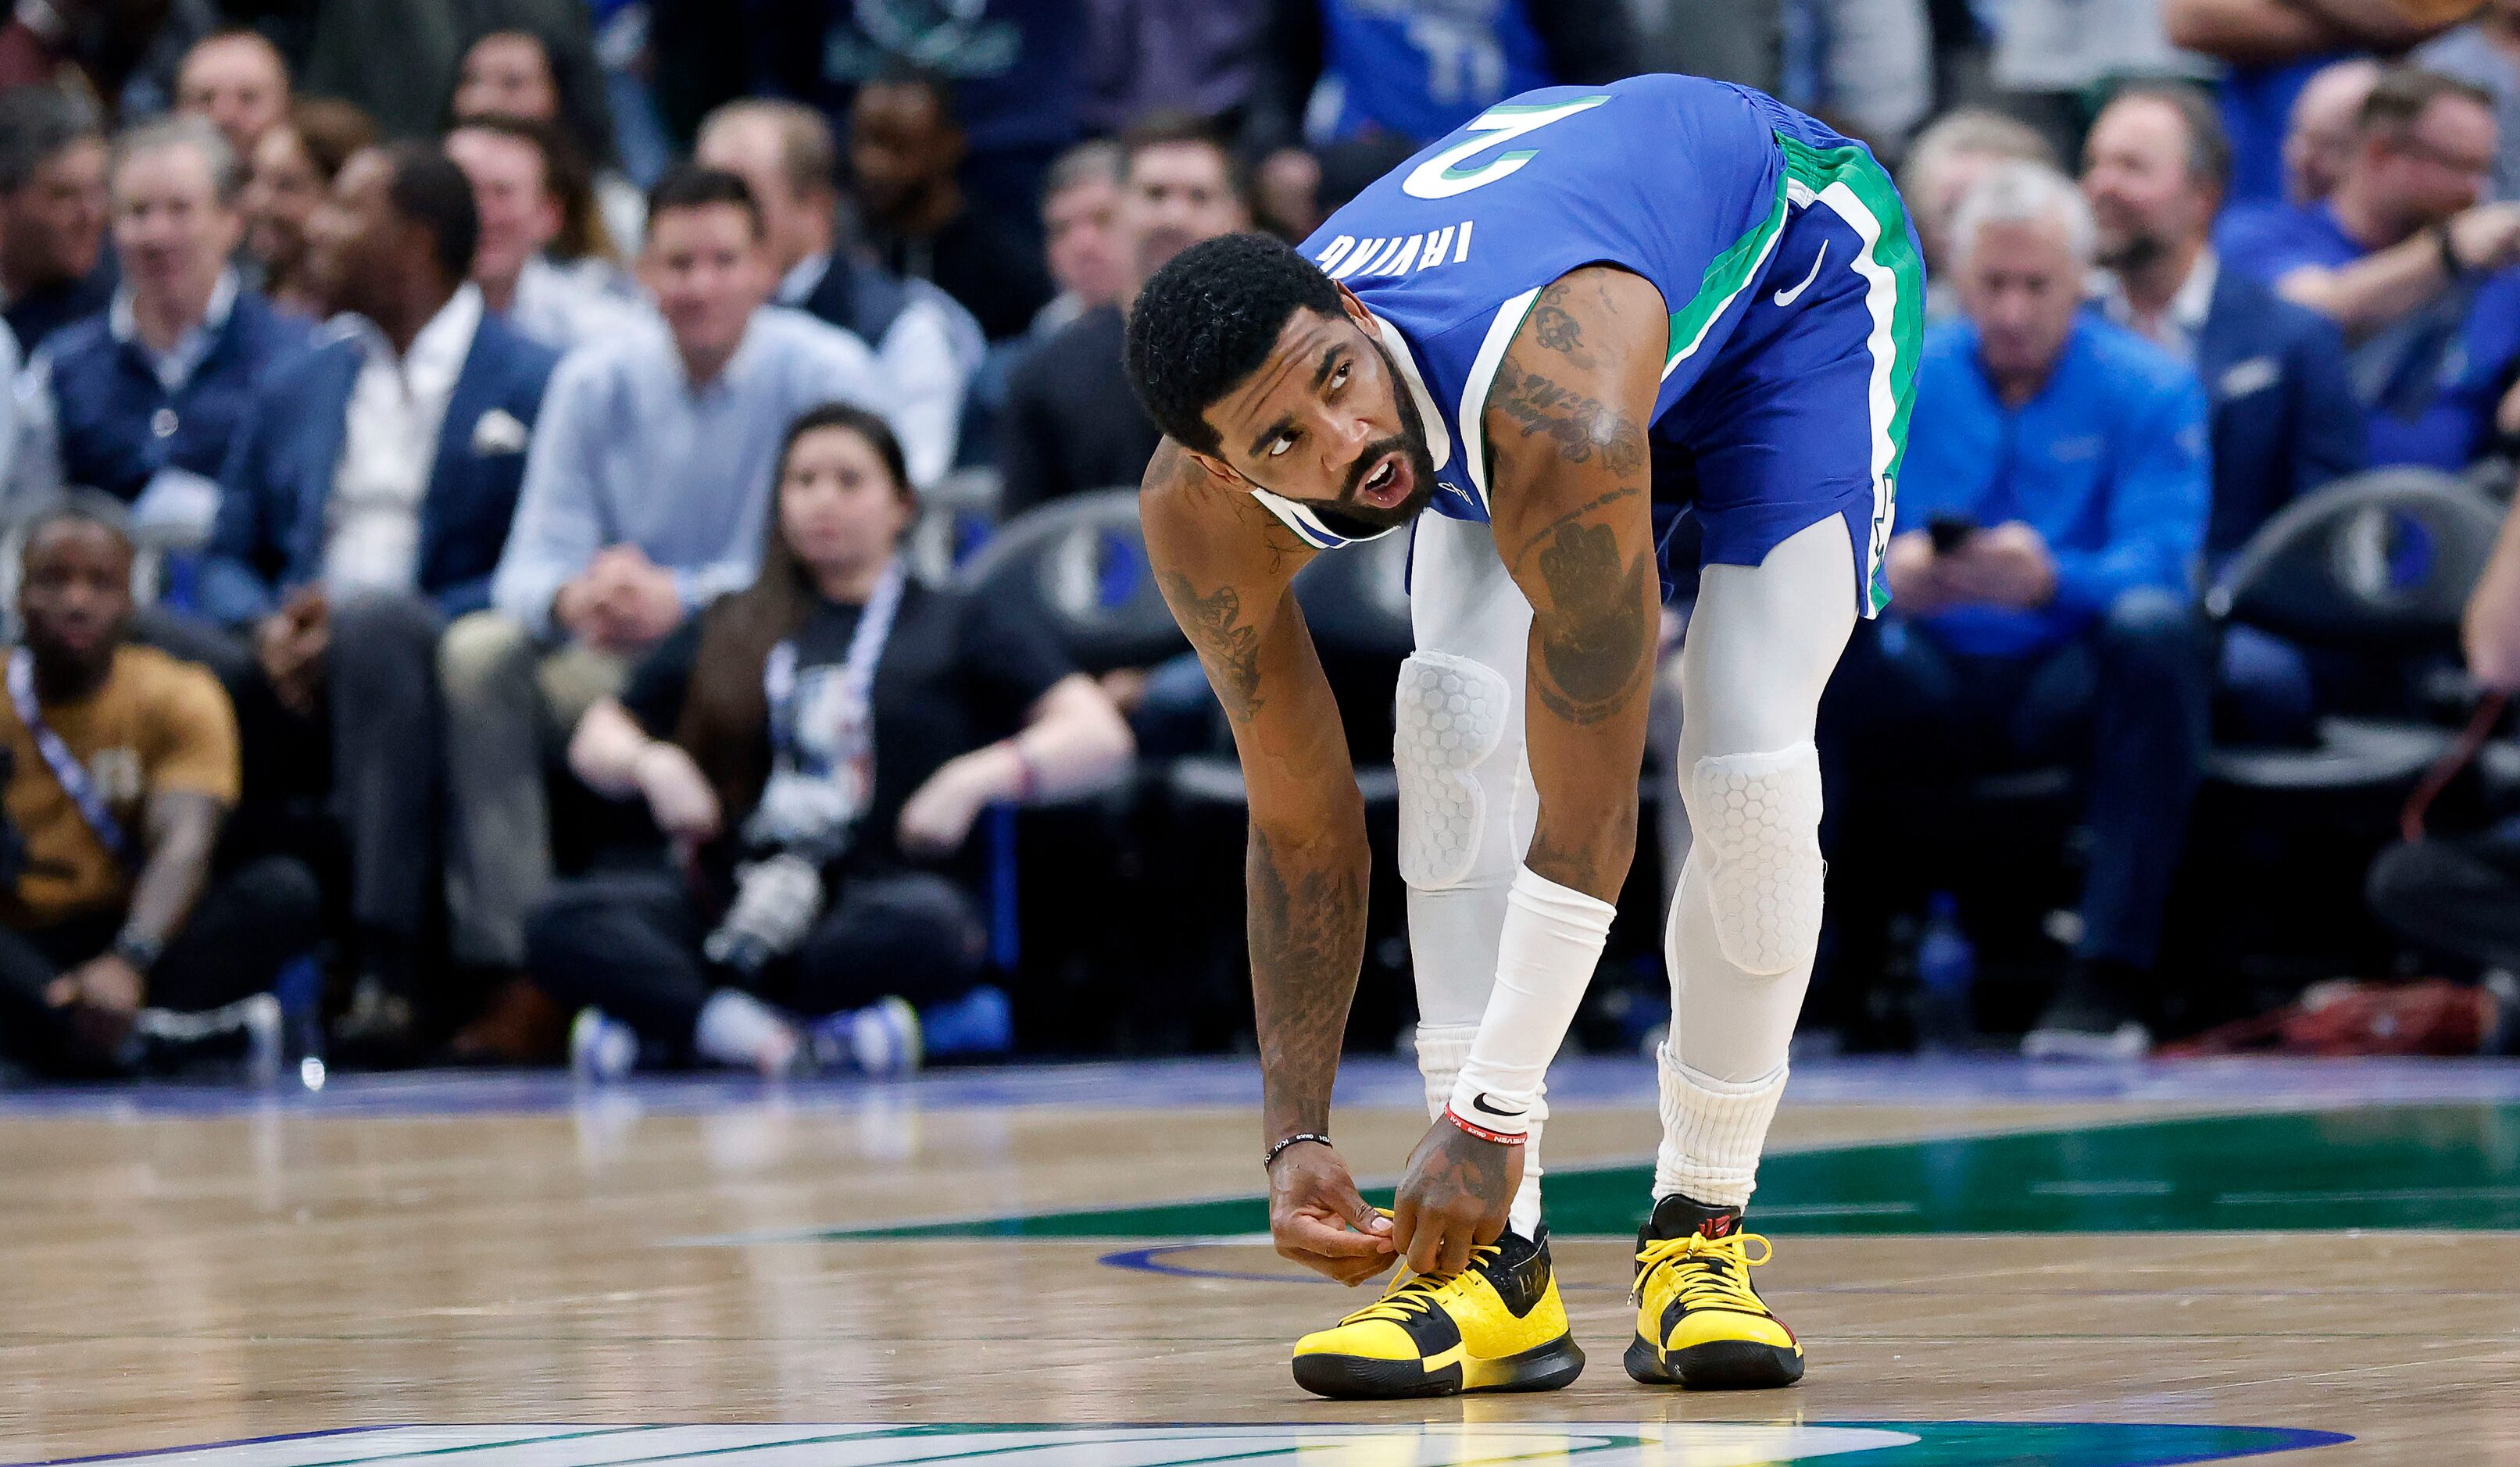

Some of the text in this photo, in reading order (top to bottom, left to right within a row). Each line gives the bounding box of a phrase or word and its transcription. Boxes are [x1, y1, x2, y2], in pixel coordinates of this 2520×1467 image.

[1401, 94, 1611, 200] 2
[1315, 220, 1474, 280] IRVING
[1449, 1115, 1462, 1127] KAI
[1467, 1126, 1486, 1138] deuce
[1274, 1138, 1289, 1151] KAI
